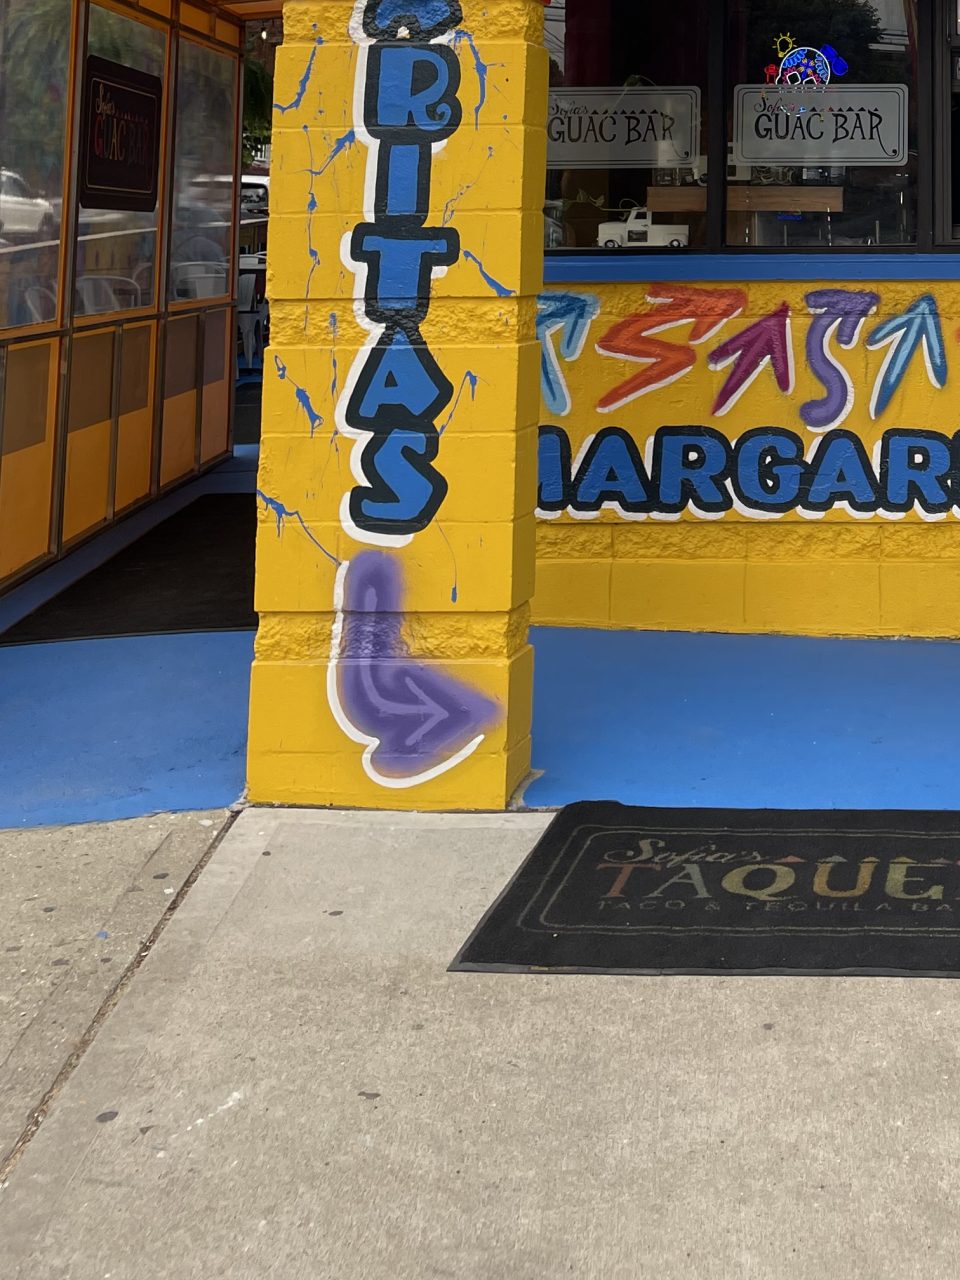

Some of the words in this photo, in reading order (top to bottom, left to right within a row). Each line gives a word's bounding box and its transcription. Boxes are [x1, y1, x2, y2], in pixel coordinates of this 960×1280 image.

[94, 115, 127, 161] GUAC
[547, 116, 617, 143] GUAC
[624, 111, 690, 158] BAR
[755, 112, 824, 140] GUAC
[832, 109, 898, 157] BAR
[603, 838, 765, 869] Sofia's
[598, 899, 686, 911] TACO
